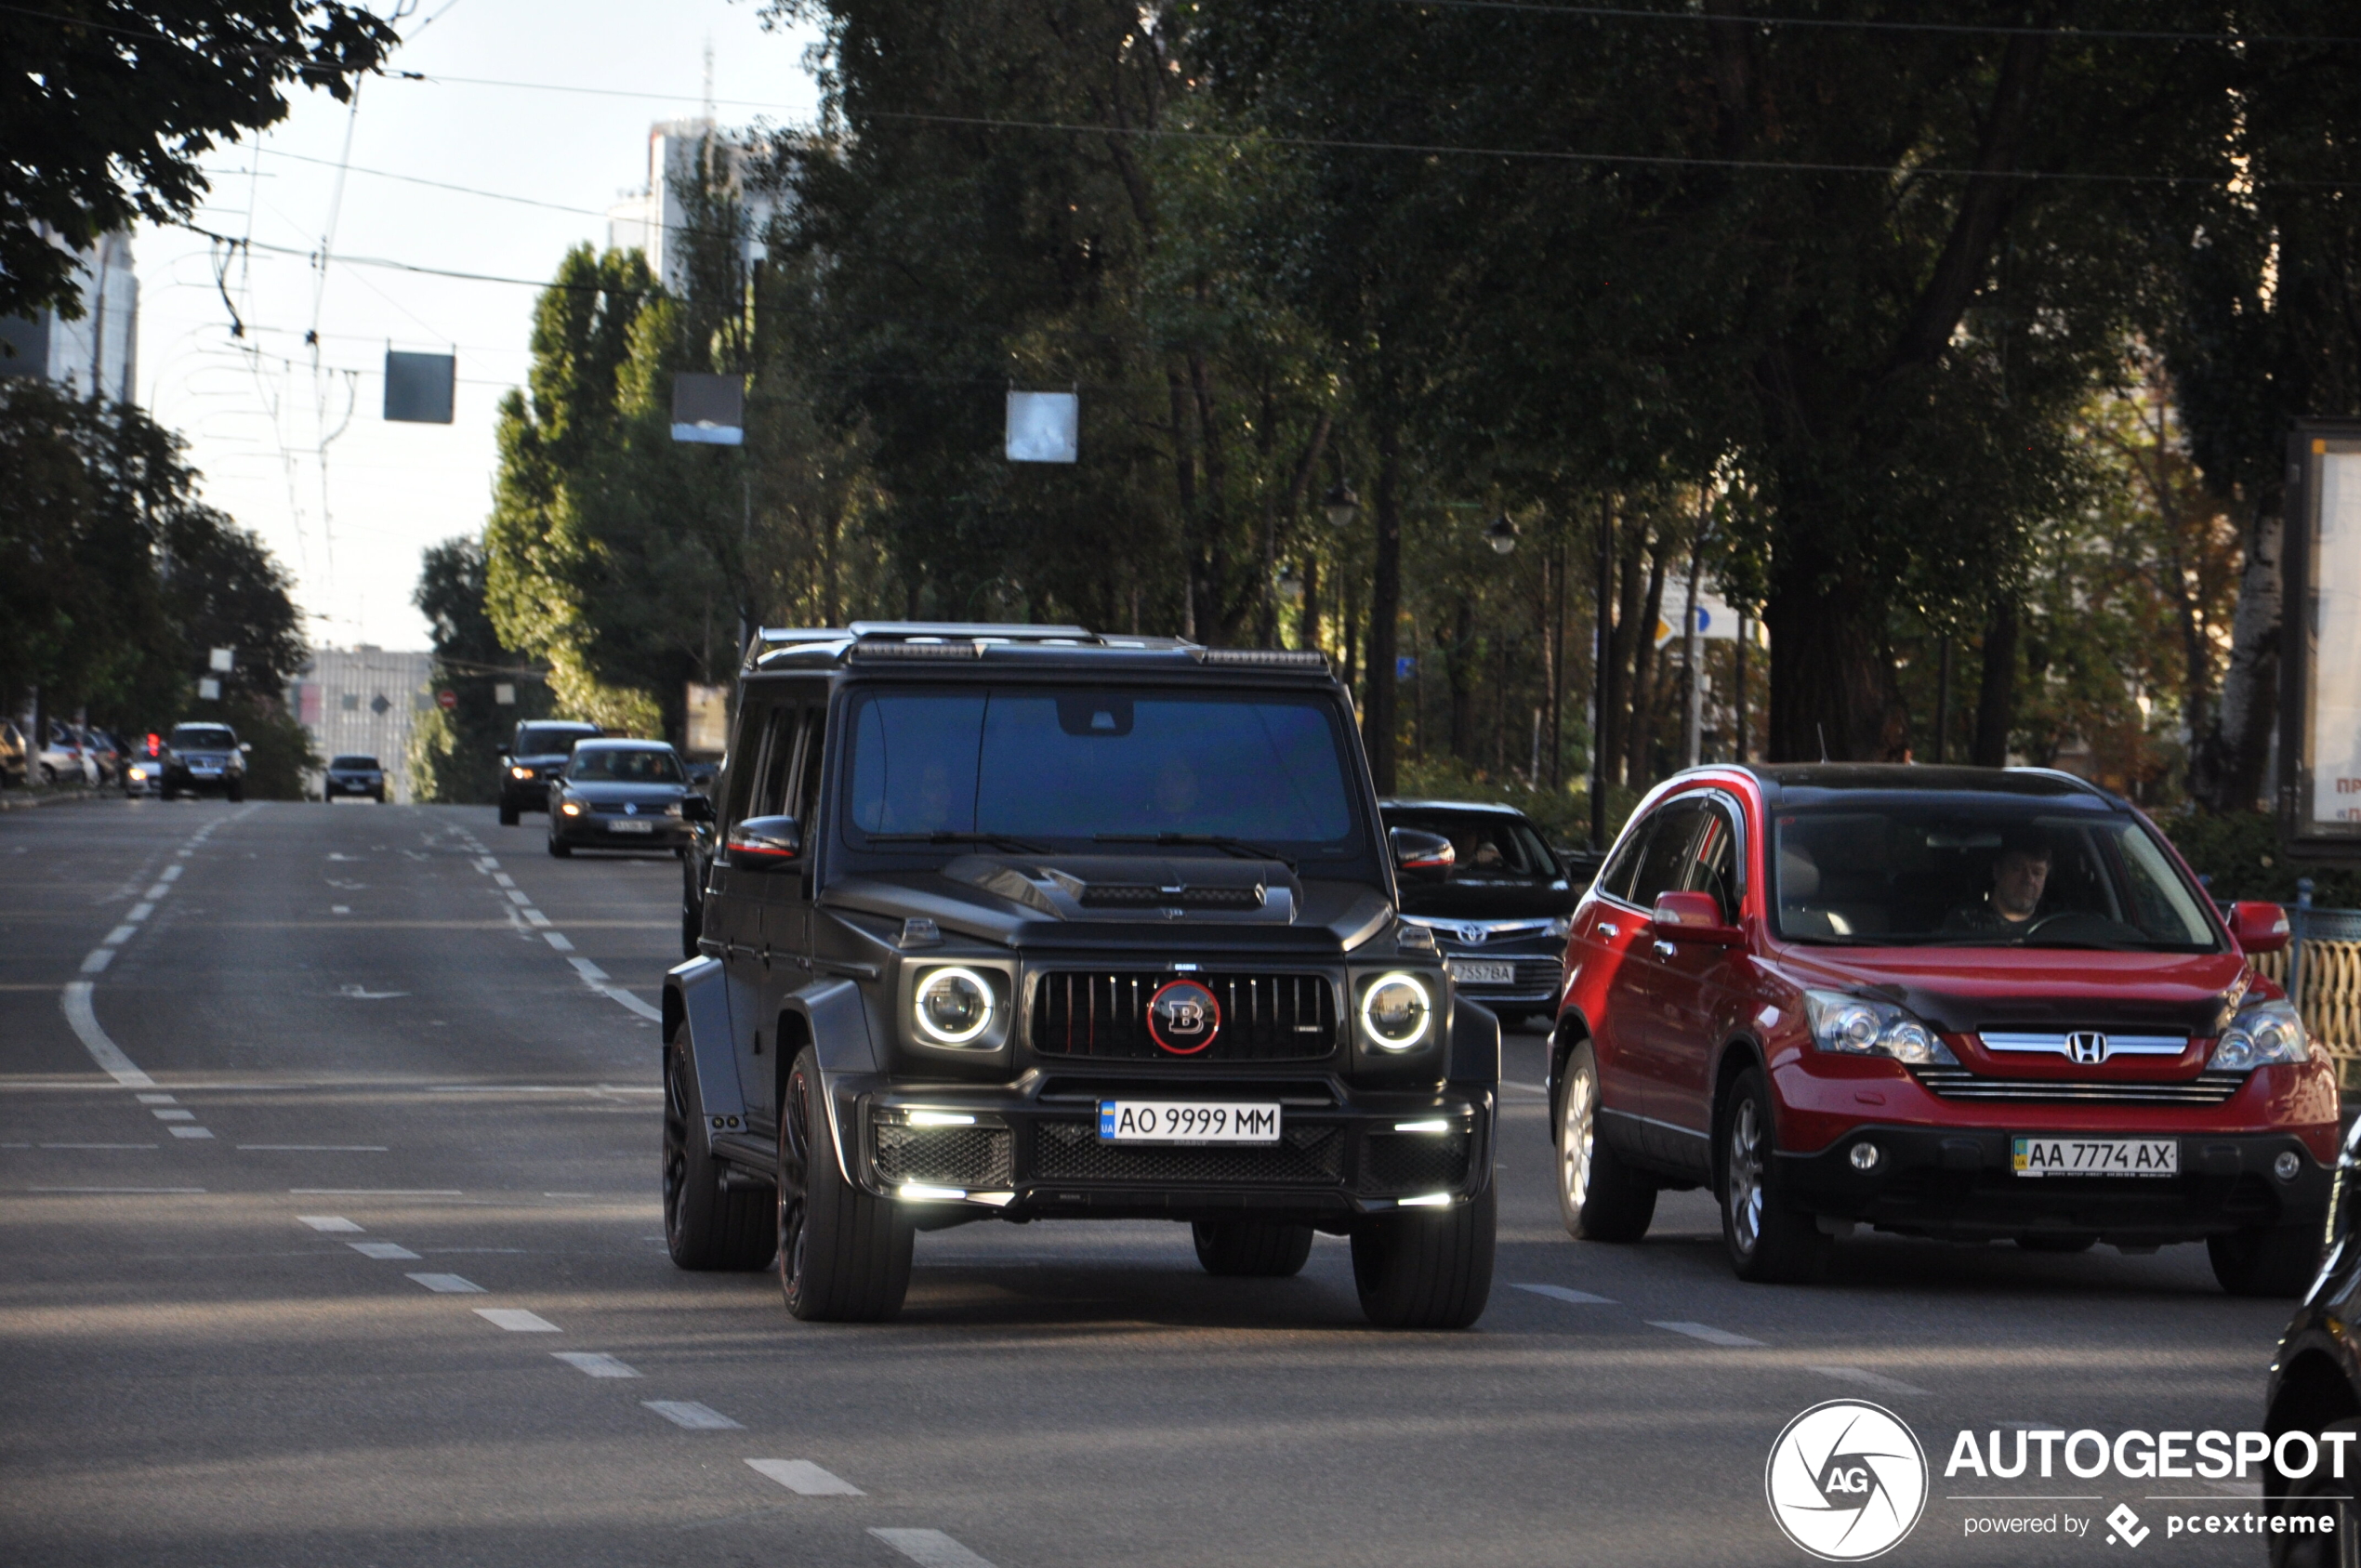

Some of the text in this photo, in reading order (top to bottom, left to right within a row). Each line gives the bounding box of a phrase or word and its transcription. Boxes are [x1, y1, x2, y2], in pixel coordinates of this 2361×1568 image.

[1168, 1001, 1205, 1034] B
[1101, 1124, 1114, 1134] UA
[1118, 1107, 1274, 1135] AO 9999 MM
[2029, 1143, 2170, 1168] AA 7774 AX
